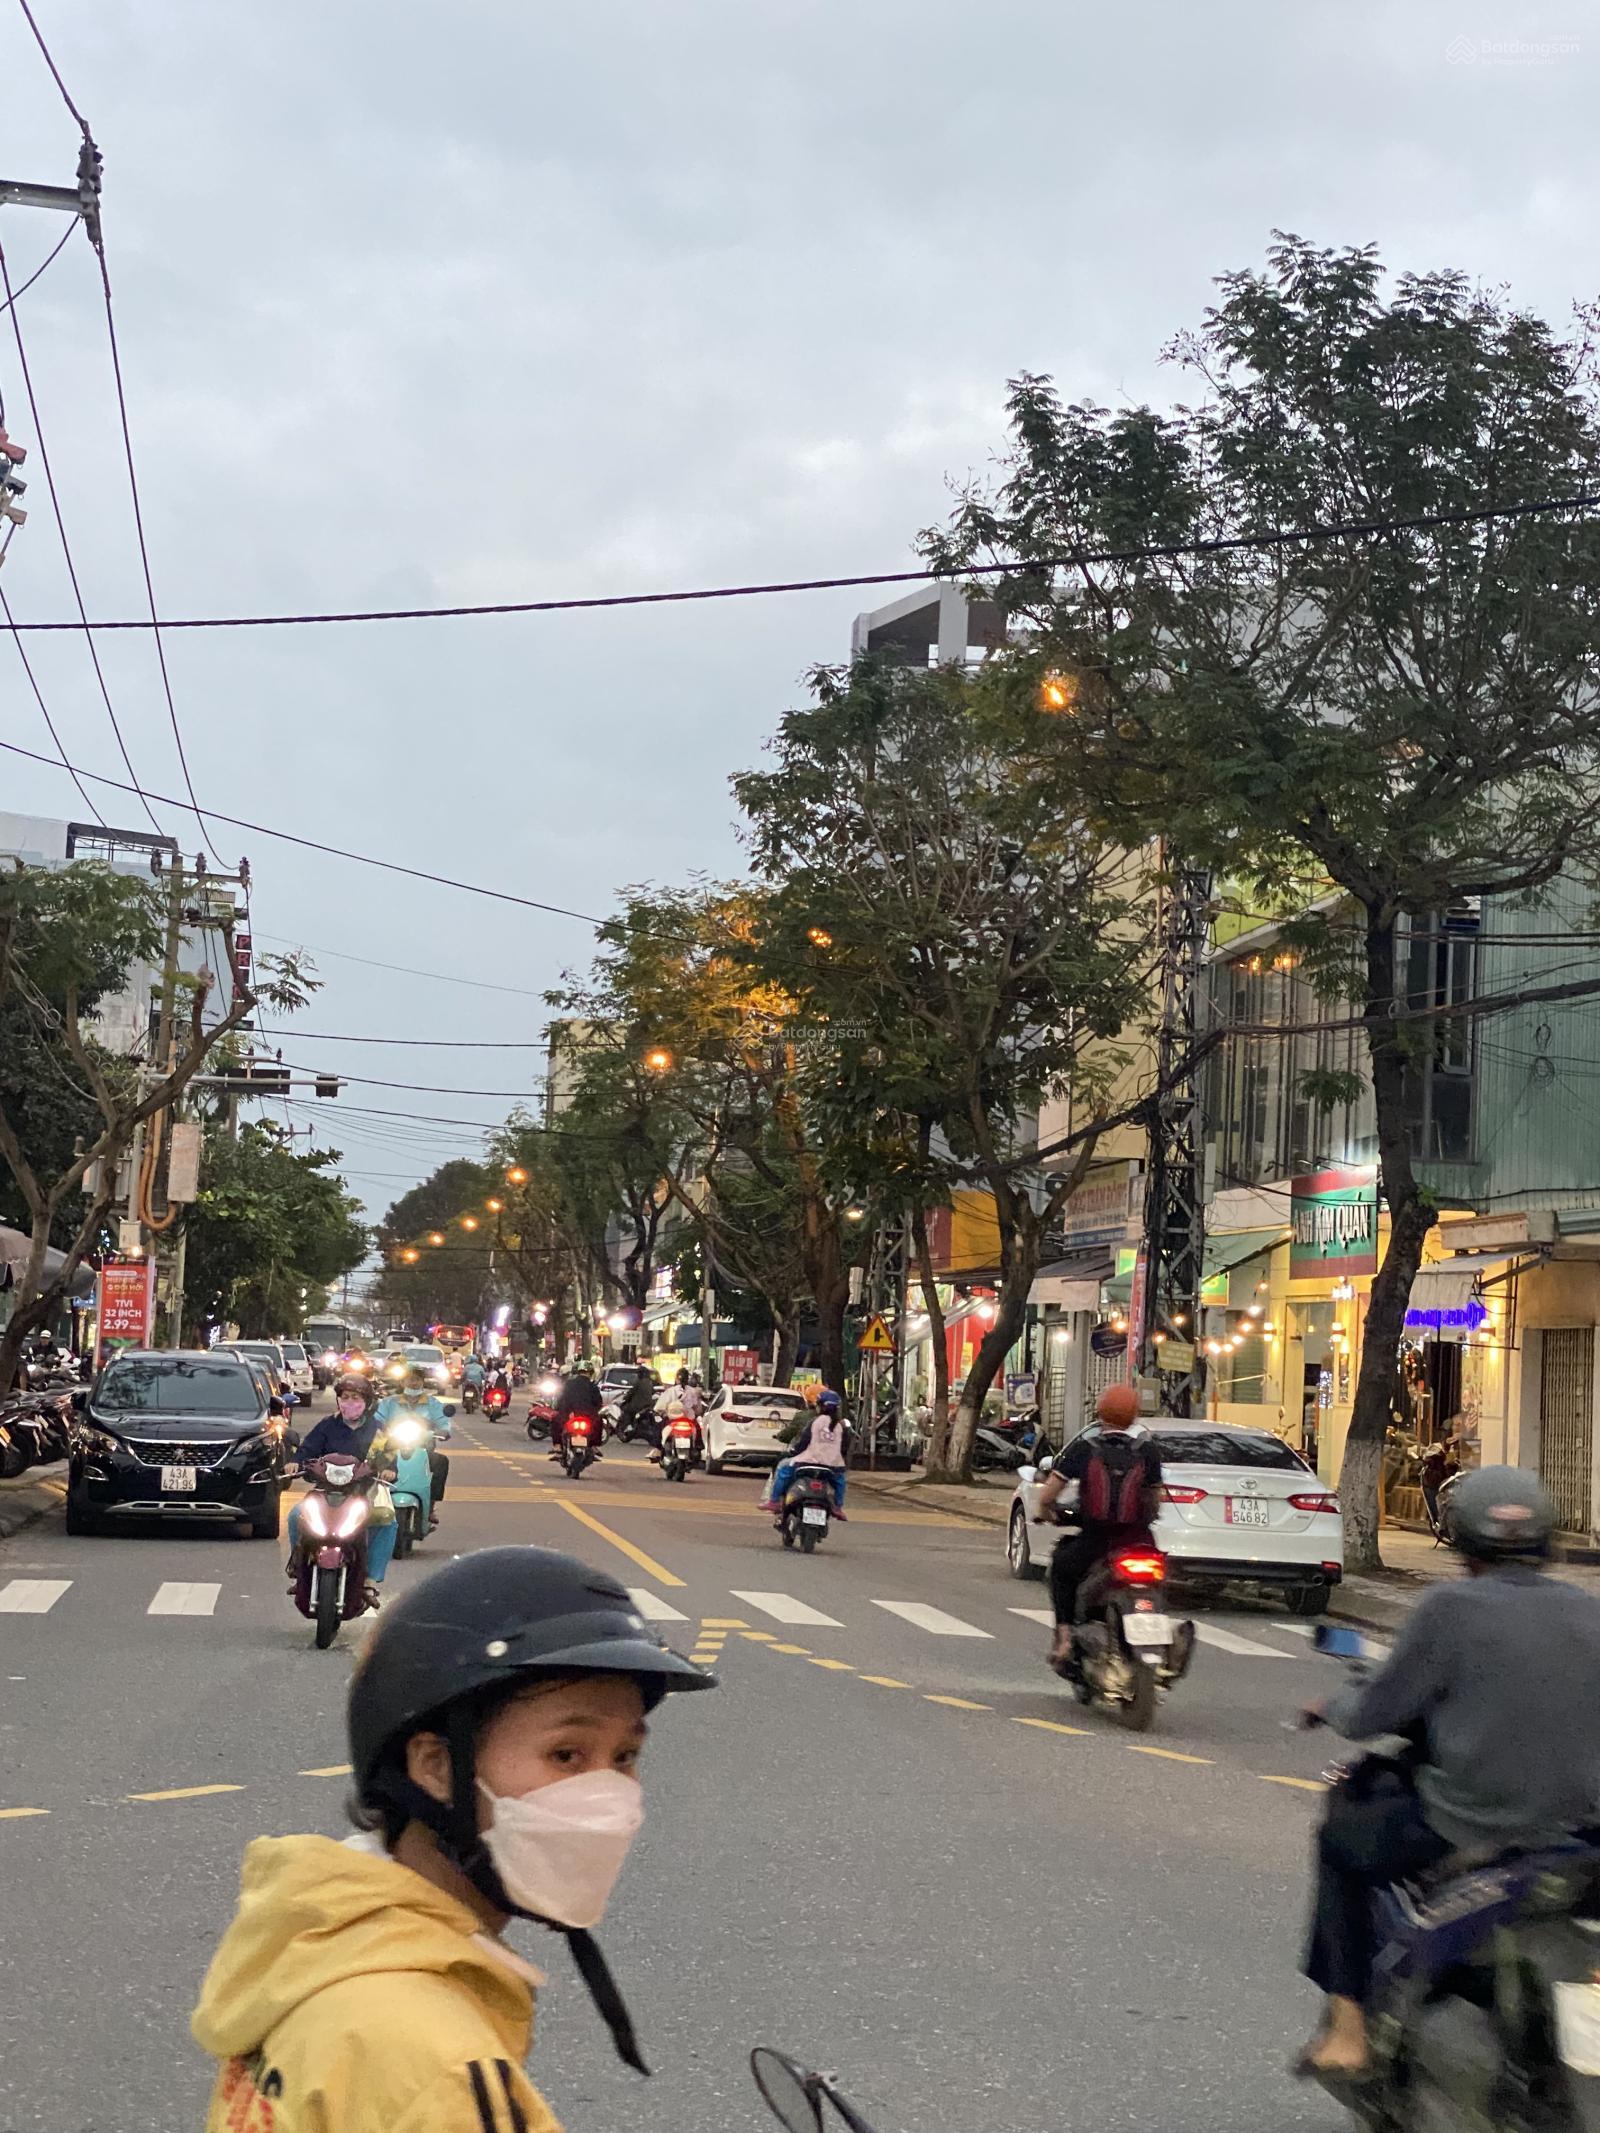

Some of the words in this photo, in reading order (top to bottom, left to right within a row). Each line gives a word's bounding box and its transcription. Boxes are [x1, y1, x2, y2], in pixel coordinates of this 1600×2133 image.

[115, 1299, 133, 1308] TIVI
[105, 1309, 117, 1317] 32
[118, 1309, 142, 1318] INCH
[103, 1319, 129, 1330] 2.99
[170, 1468, 187, 1478] 43A
[1240, 1500, 1259, 1511] 43A
